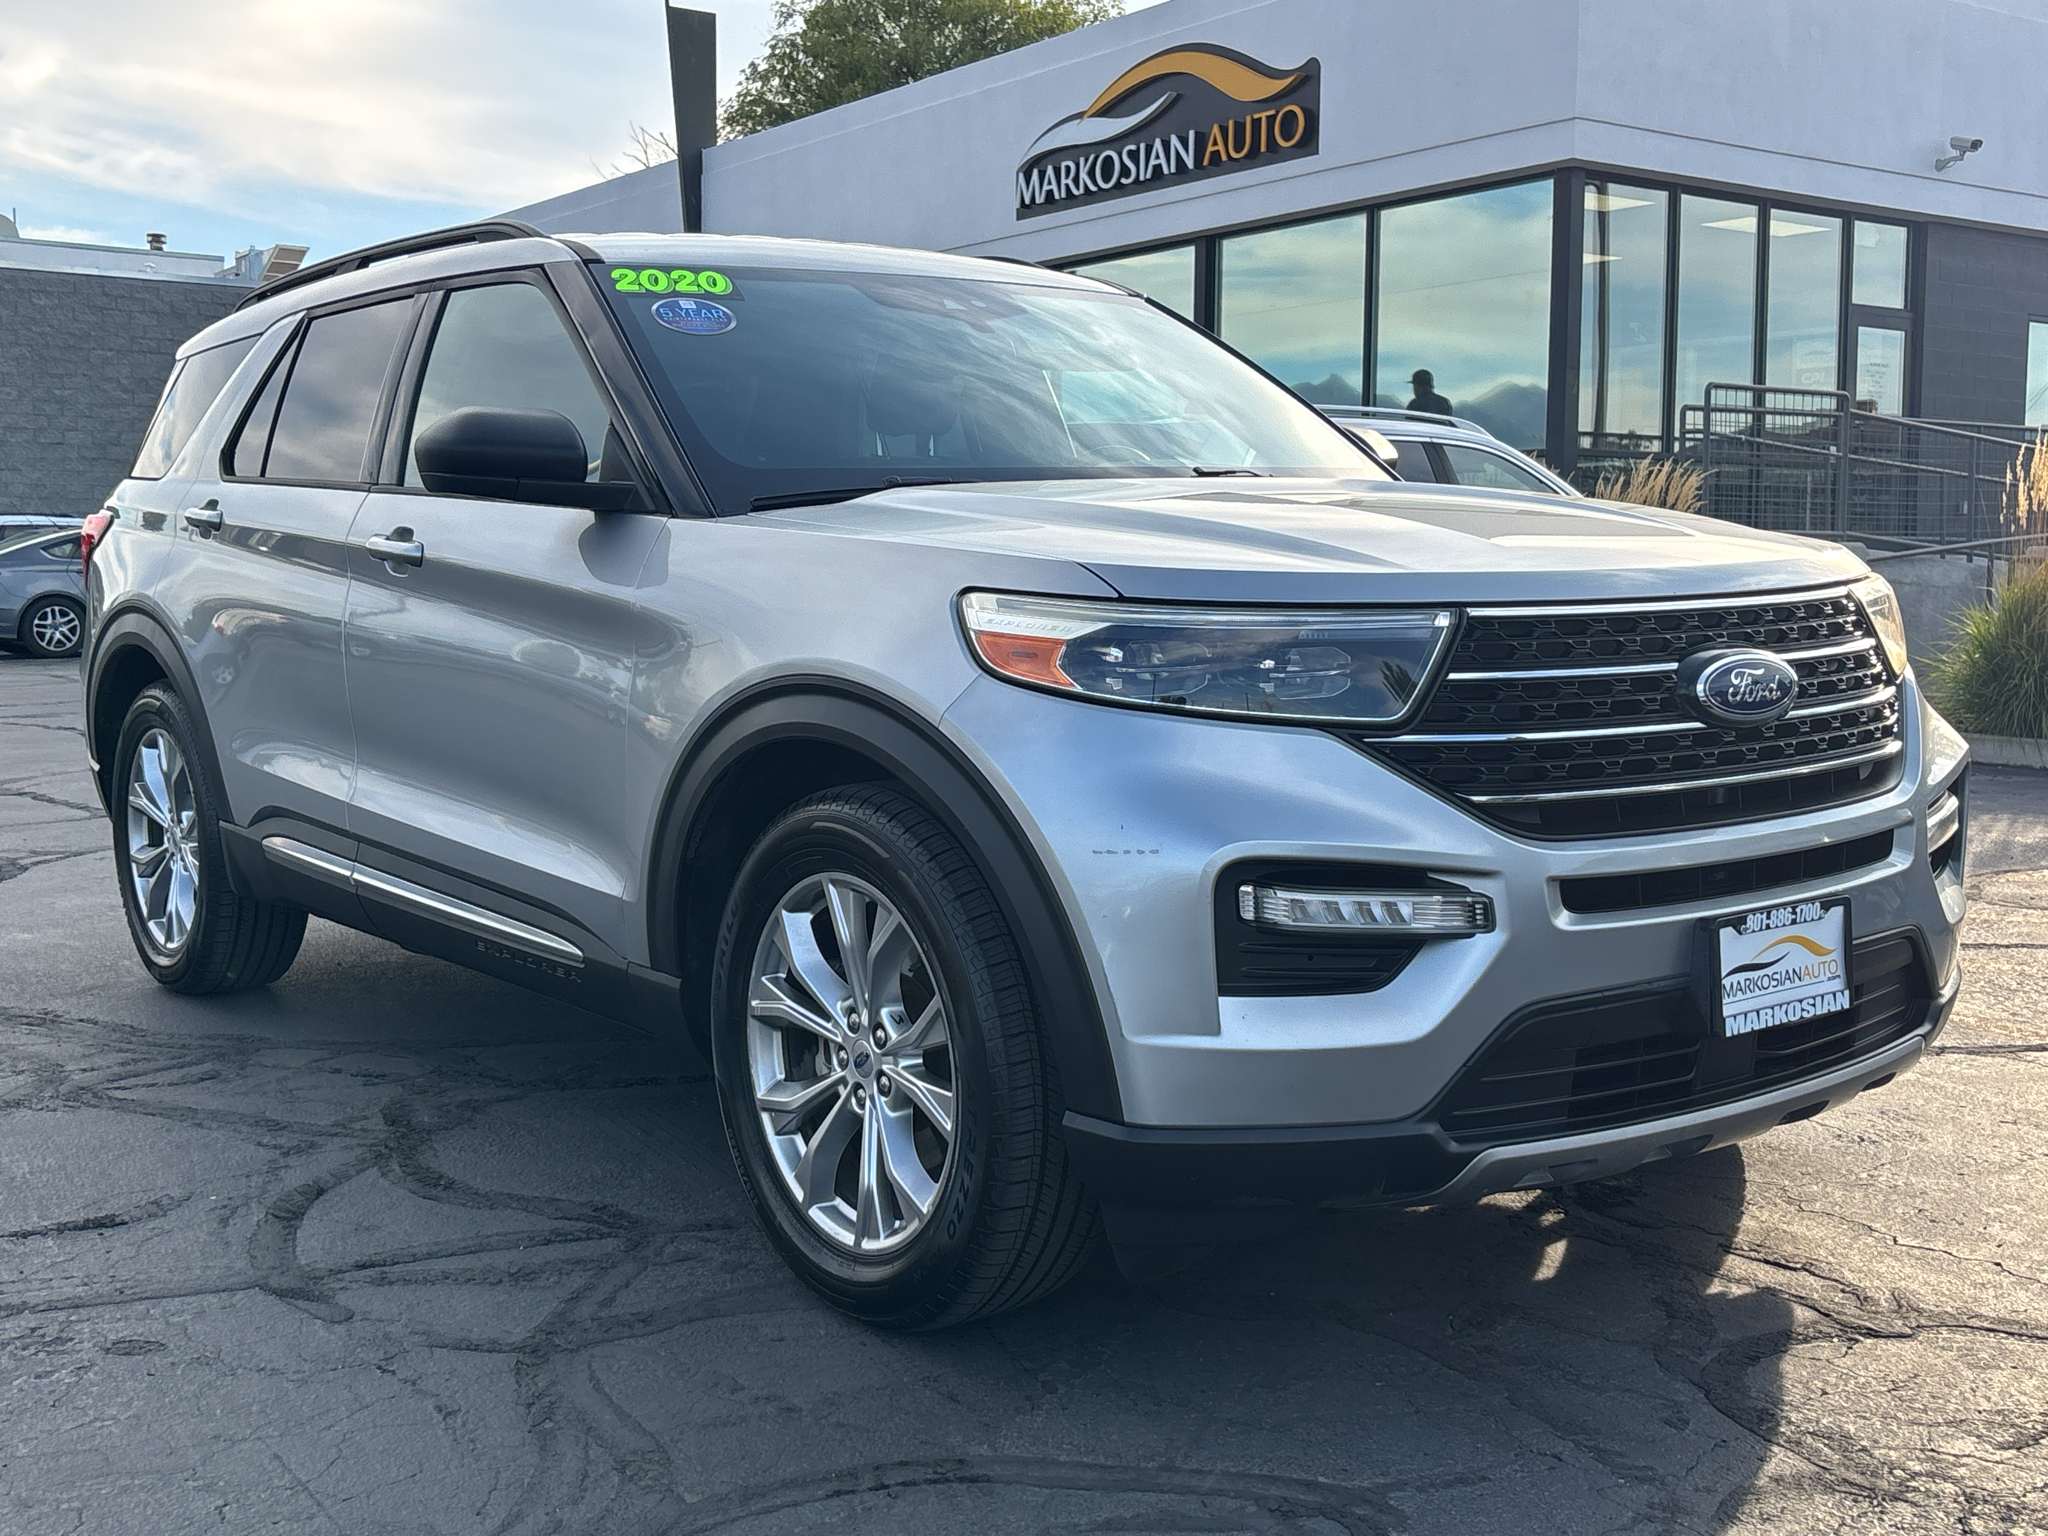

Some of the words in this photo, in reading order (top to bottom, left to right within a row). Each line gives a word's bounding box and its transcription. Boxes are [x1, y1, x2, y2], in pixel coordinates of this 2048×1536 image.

[1018, 129, 1195, 209] MARKOSIAN
[1202, 104, 1306, 167] AUTO
[611, 268, 733, 295] 2020
[659, 307, 674, 318] 5
[675, 307, 726, 319] YEAR
[984, 618, 1073, 633] EXPLORER
[1728, 668, 1782, 705] Ford
[1725, 989, 1850, 1037] MARKOSIAN
